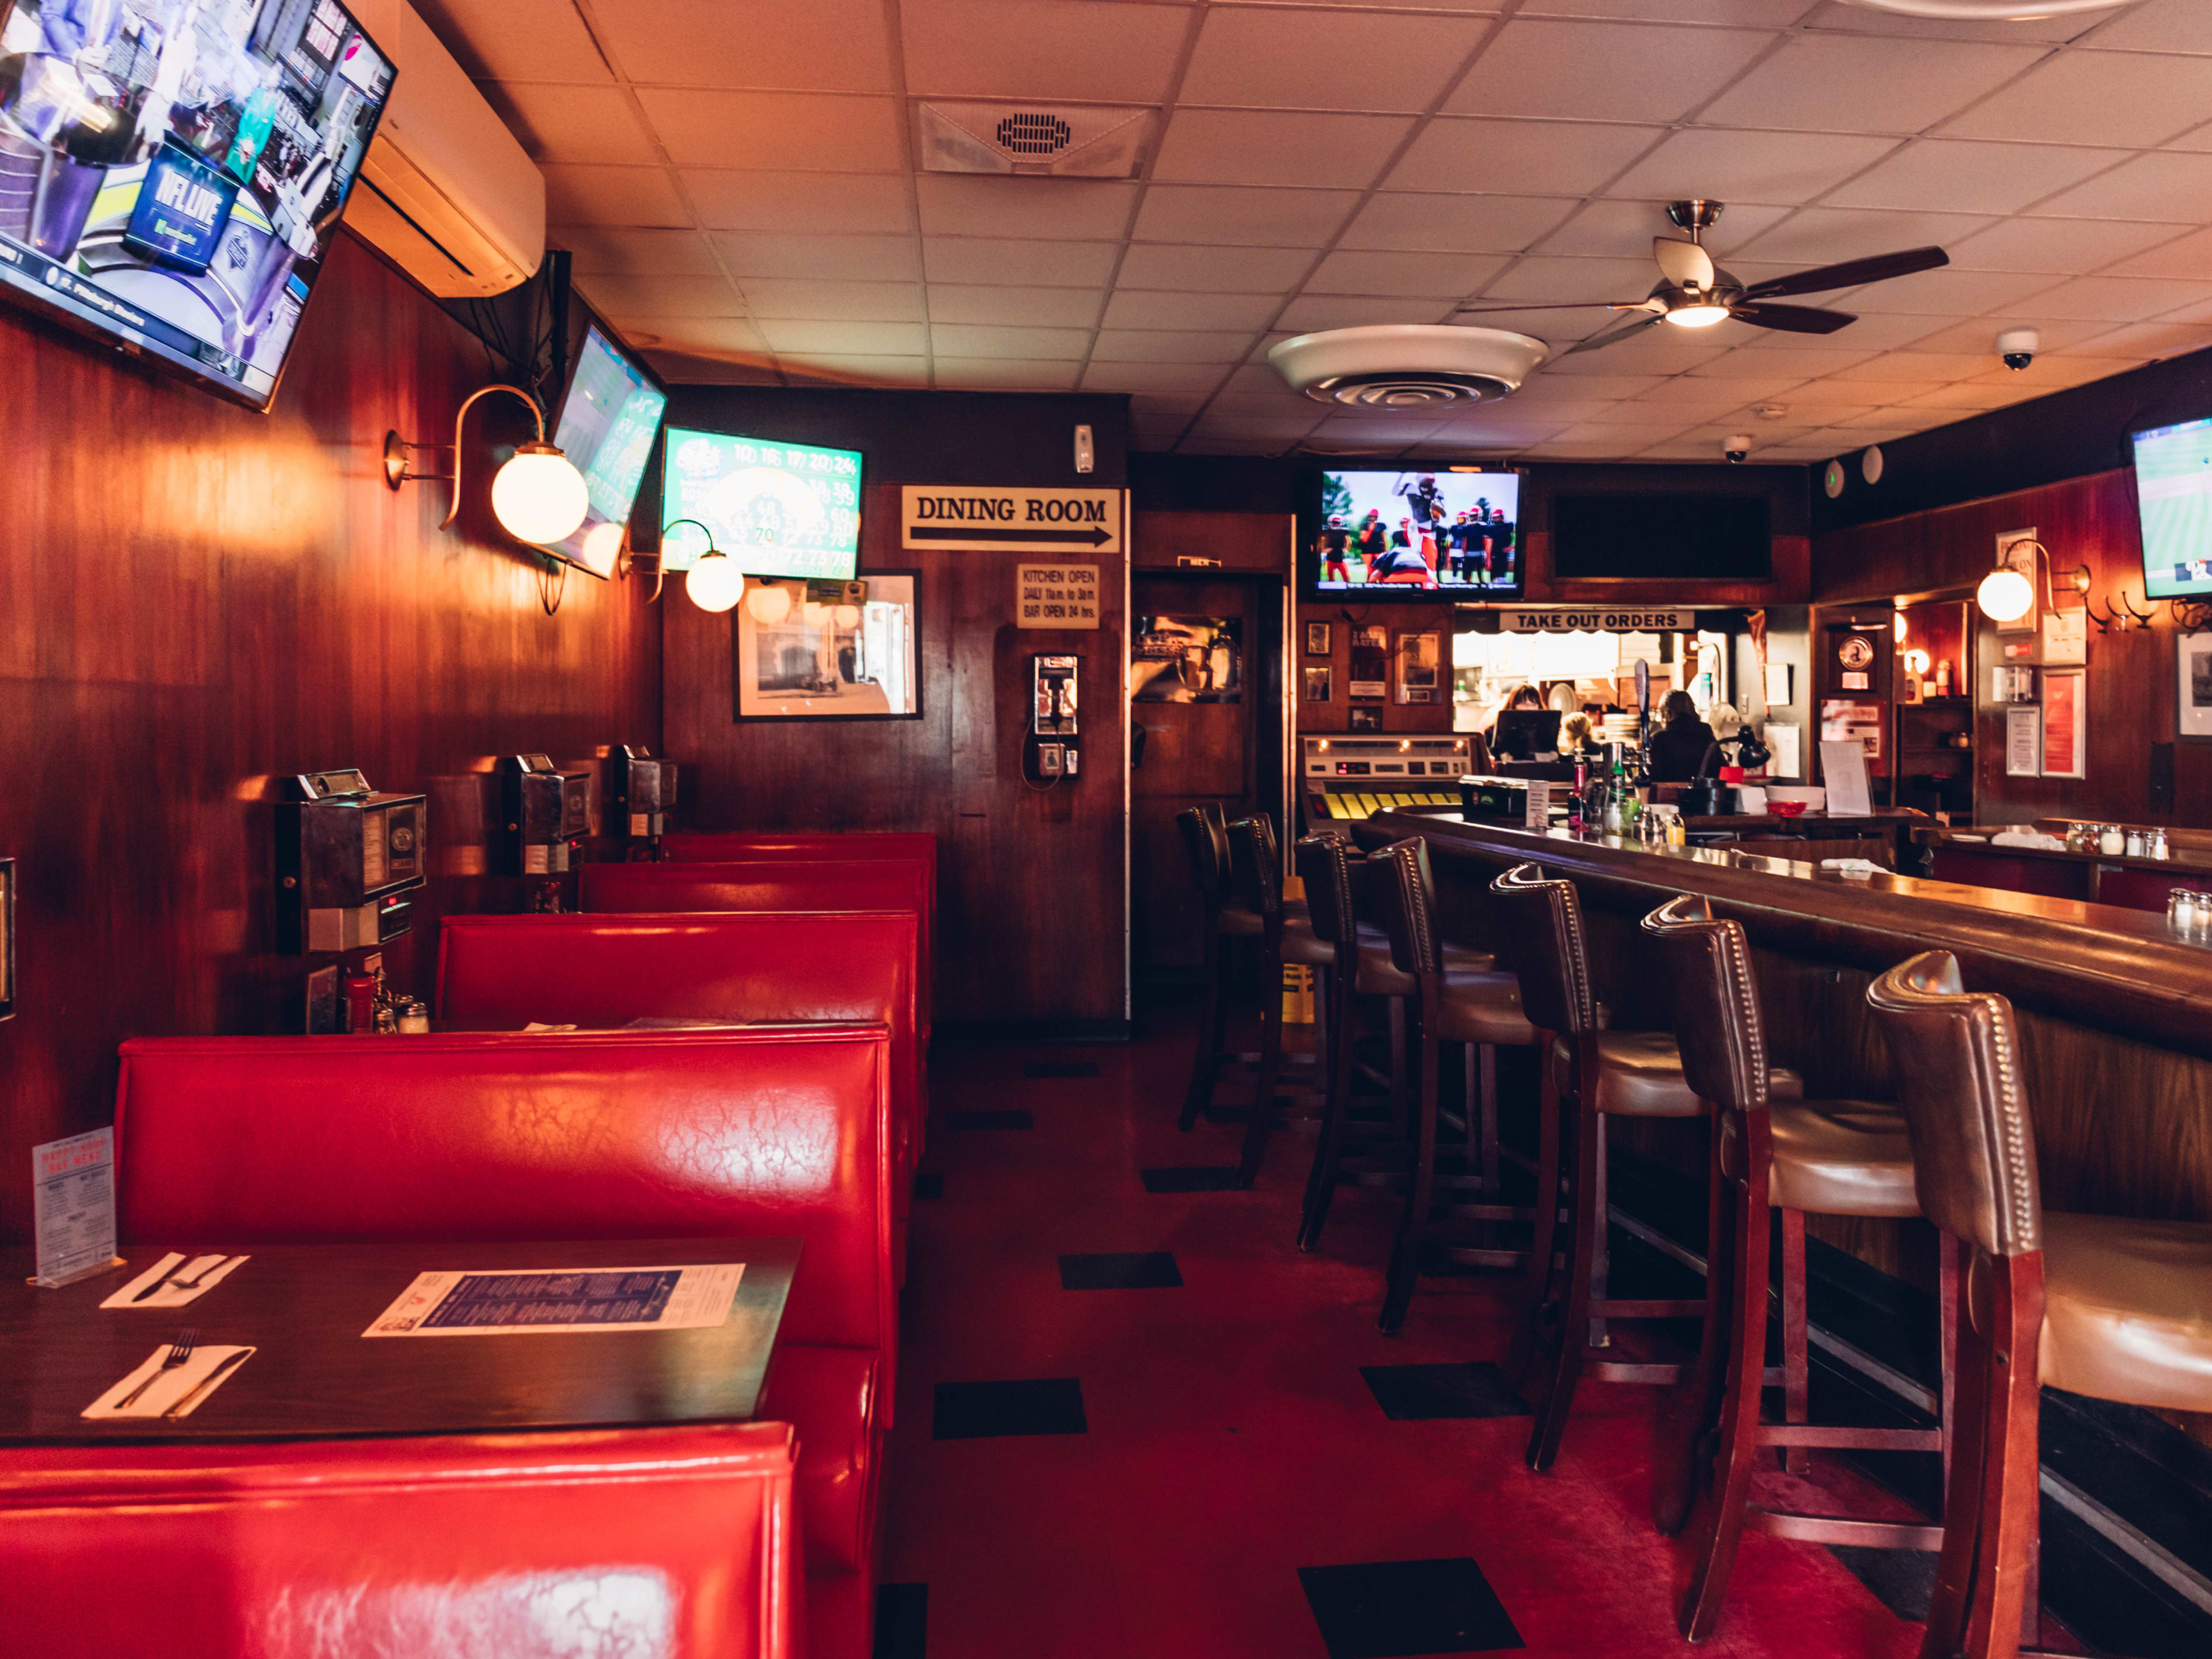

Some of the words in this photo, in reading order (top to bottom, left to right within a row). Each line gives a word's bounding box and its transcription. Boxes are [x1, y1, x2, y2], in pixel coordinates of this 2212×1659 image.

[155, 168, 190, 213] NFL
[183, 184, 223, 226] LIVE
[917, 497, 1016, 521] DINING
[1025, 499, 1106, 522] ROOM
[1023, 570, 1065, 583] KITCHEN
[1069, 570, 1095, 583] OPEN
[1024, 587, 1042, 600] DAILY
[1067, 588, 1075, 600] to
[1024, 605, 1040, 618] BAR
[1043, 605, 1065, 618] OPEN
[1069, 605, 1078, 618] 24
[1517, 615, 1561, 627] TAKE
[1566, 614, 1601, 627] OUT
[1605, 613, 1678, 627] ORDERS
